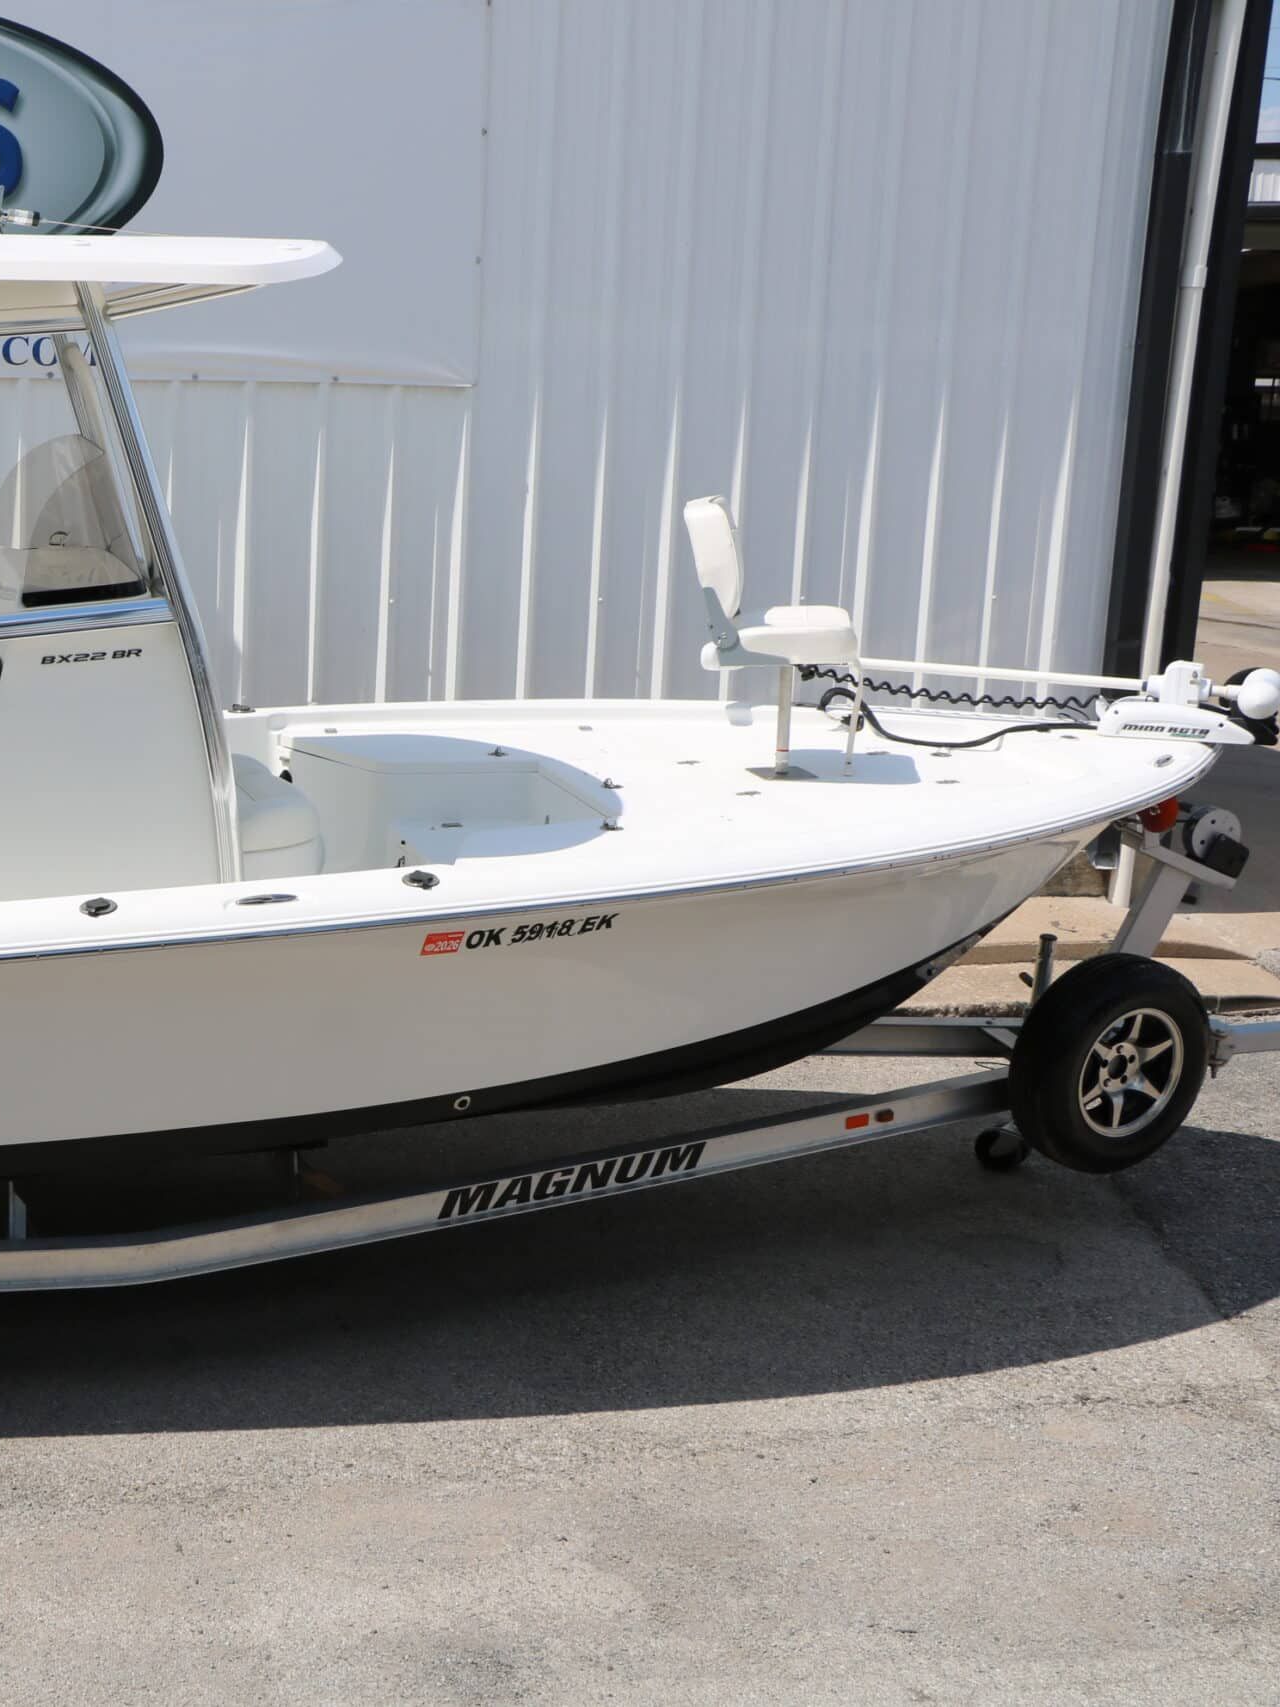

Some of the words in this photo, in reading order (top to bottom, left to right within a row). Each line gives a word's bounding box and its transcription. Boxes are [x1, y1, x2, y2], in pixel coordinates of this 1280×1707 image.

[41, 652, 107, 665] BX22
[111, 648, 143, 659] BR
[465, 927, 507, 949] OK
[508, 918, 576, 945] 5918
[577, 913, 620, 935] EK
[437, 1141, 707, 1220] MAGNUM
